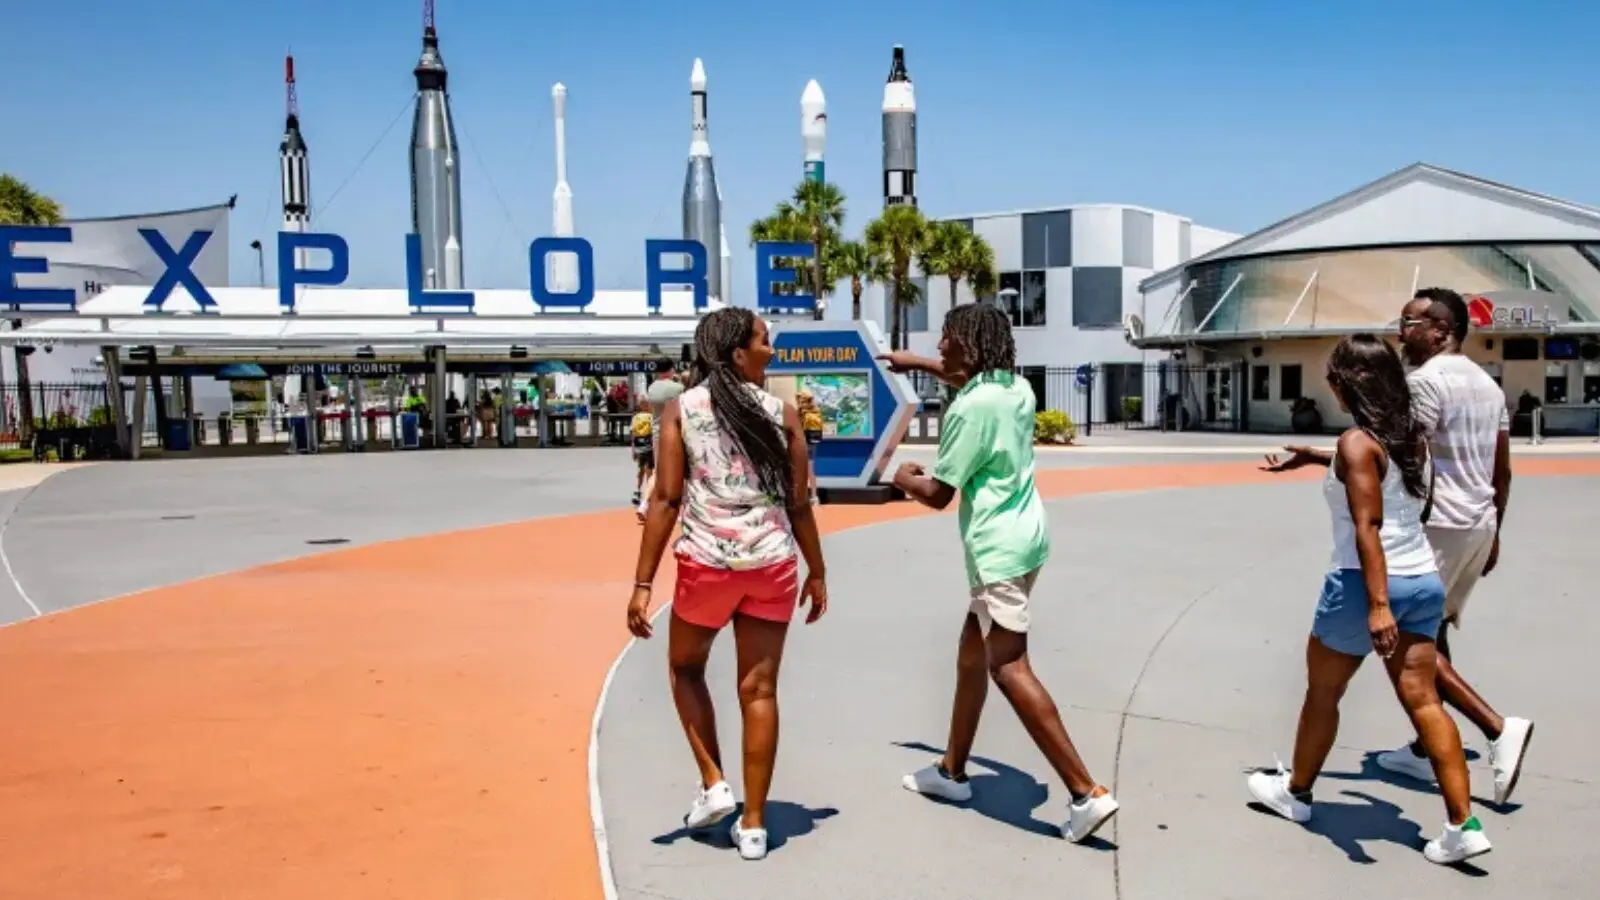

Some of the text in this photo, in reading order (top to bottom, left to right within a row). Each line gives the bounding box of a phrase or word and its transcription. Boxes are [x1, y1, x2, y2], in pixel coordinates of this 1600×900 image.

[0, 225, 817, 309] EXPLORE
[777, 346, 858, 362] PLAN YOUR DAY
[286, 363, 402, 373] JOIN THE JOURNEY
[589, 361, 614, 371] JOIN
[619, 361, 639, 371] THE
